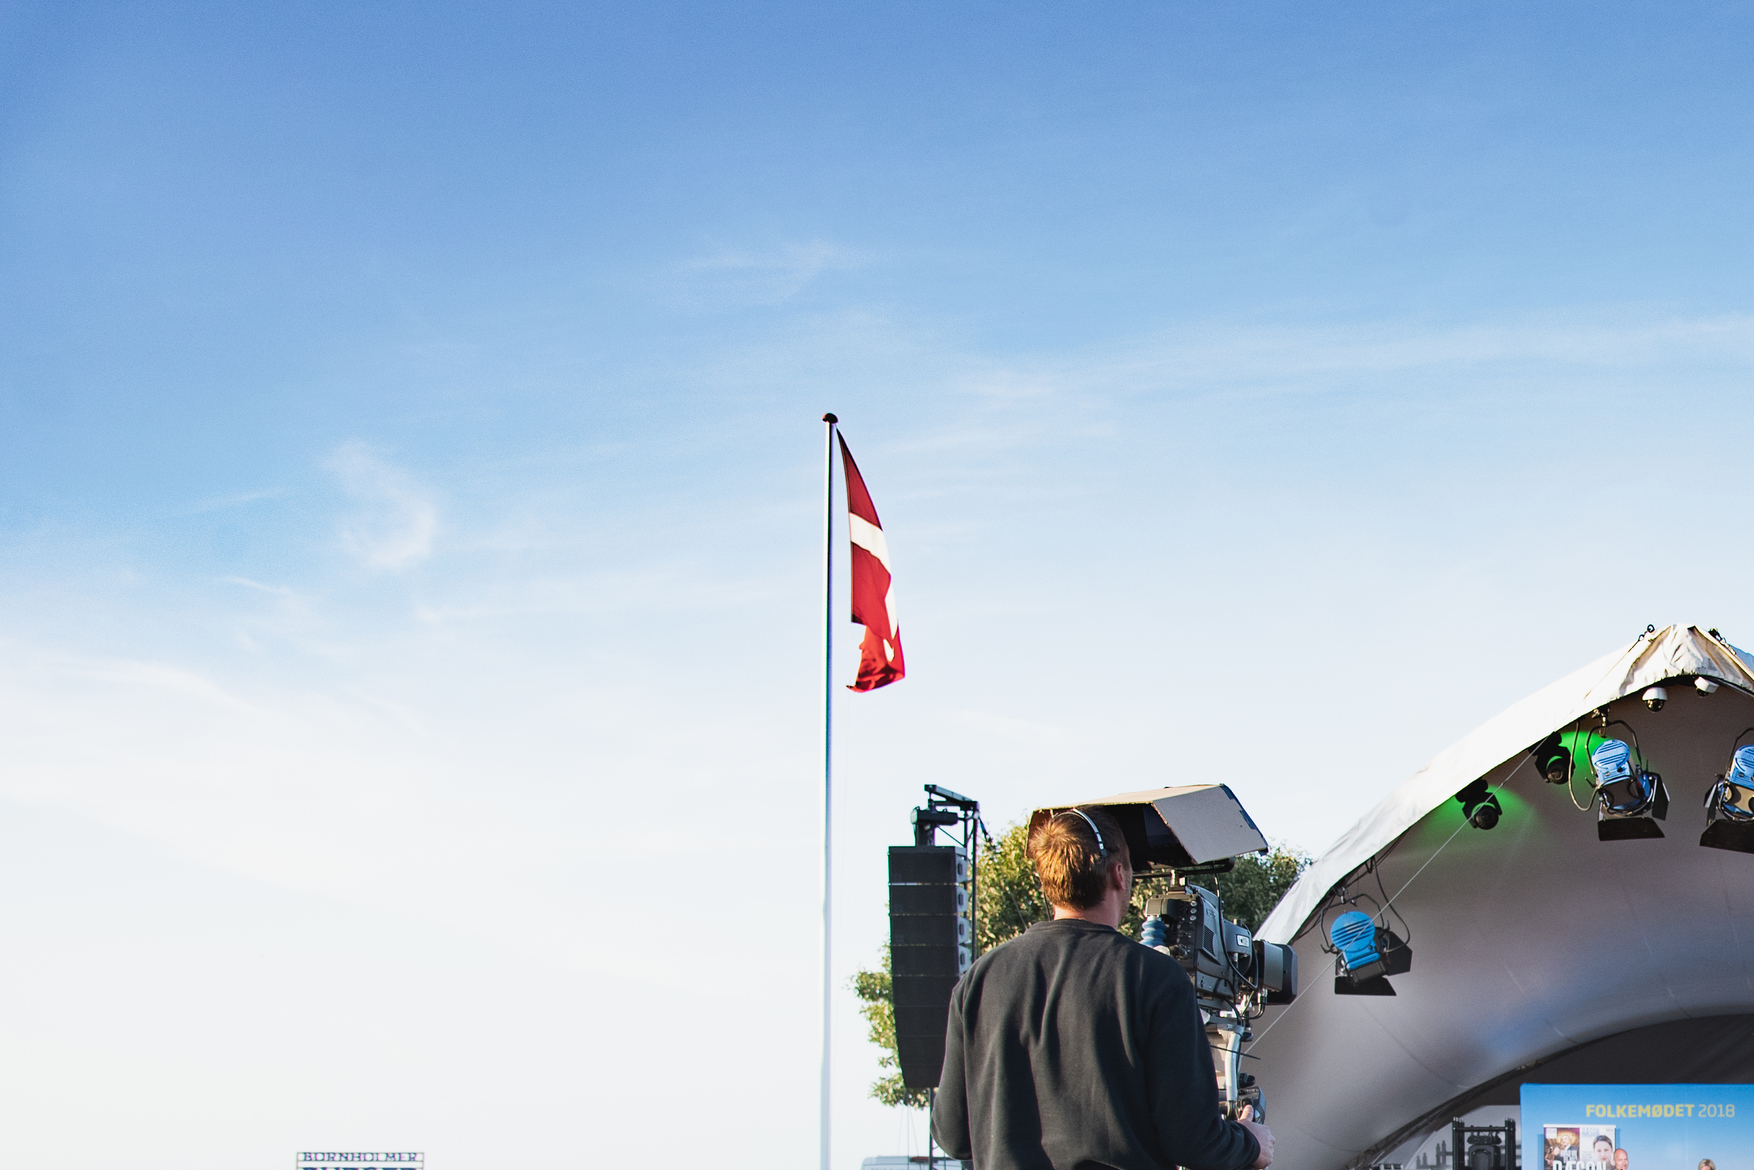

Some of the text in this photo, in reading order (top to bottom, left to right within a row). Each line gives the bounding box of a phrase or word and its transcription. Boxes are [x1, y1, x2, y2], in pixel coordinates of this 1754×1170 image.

[1586, 1104, 1735, 1118] FOLKEMØDET 2018
[302, 1152, 417, 1162] BORNHOLMER
